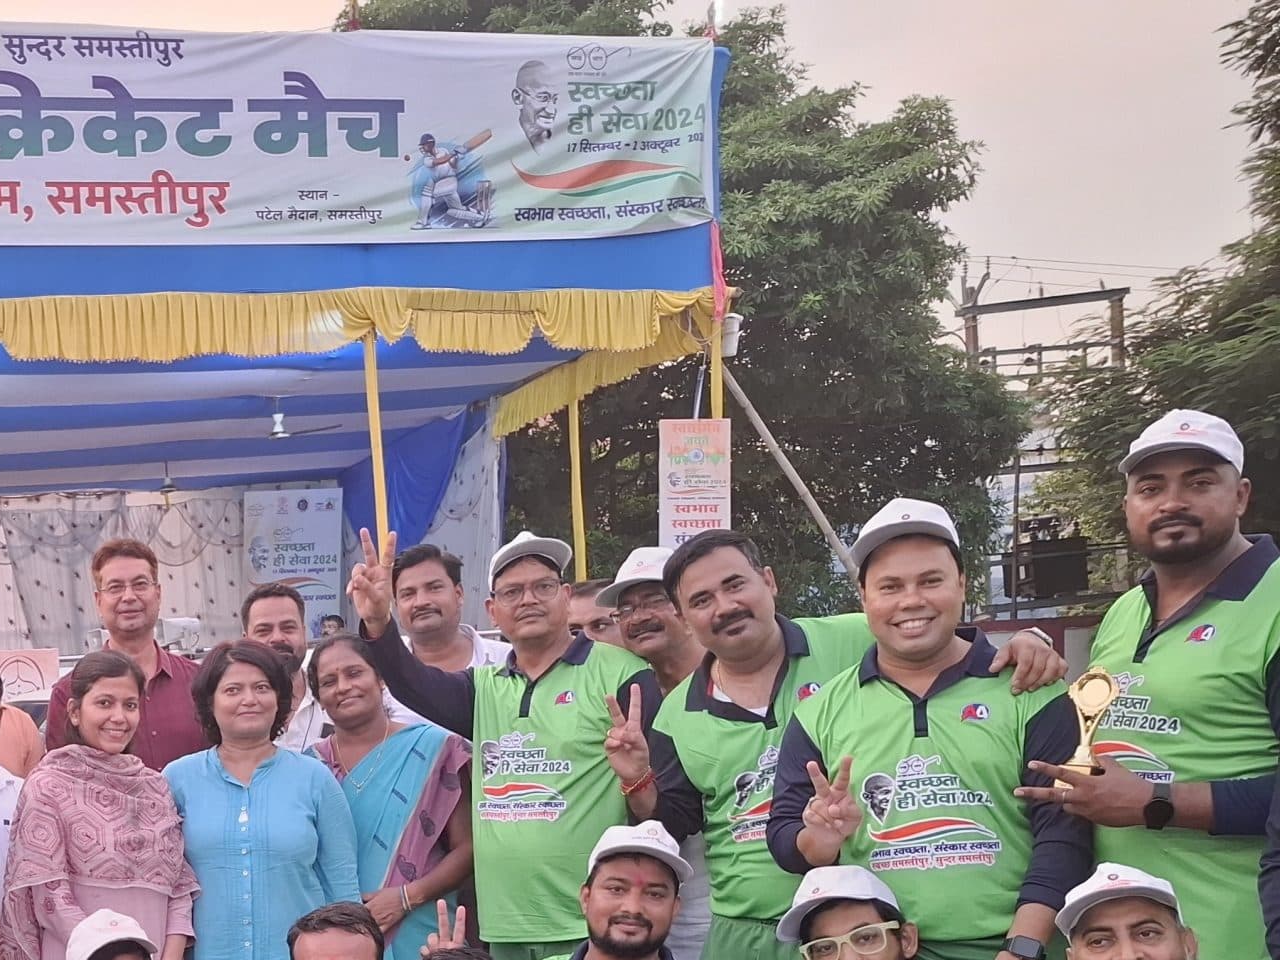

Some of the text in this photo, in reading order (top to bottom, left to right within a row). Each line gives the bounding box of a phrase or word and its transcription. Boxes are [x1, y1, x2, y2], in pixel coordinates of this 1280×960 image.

[2, 30, 184, 62] सुन्दर समस्तीपुर
[568, 81, 657, 102] स्वच्छता
[246, 70, 405, 159] मैच
[568, 103, 705, 135] ही सेवा 2024
[44, 168, 232, 229] समस्तीपुर
[297, 188, 328, 202] स्थान
[255, 207, 284, 223] पटेल
[326, 207, 383, 225] समस्तीपुर
[514, 207, 554, 222] स्वभाव
[558, 206, 610, 221] स्वच्छता,
[616, 200, 663, 217] संस्कार
[274, 542, 315, 552] स्वच्छता
[274, 553, 337, 566] ही सेवा 2024
[1113, 714, 1179, 732] सेवा 2024
[501, 750, 544, 759] स्वच्छता
[514, 762, 539, 773] सेवा
[542, 762, 570, 773] 2024
[897, 776, 959, 791] स्वच्छता
[898, 791, 993, 809] ही सेवा 2024
